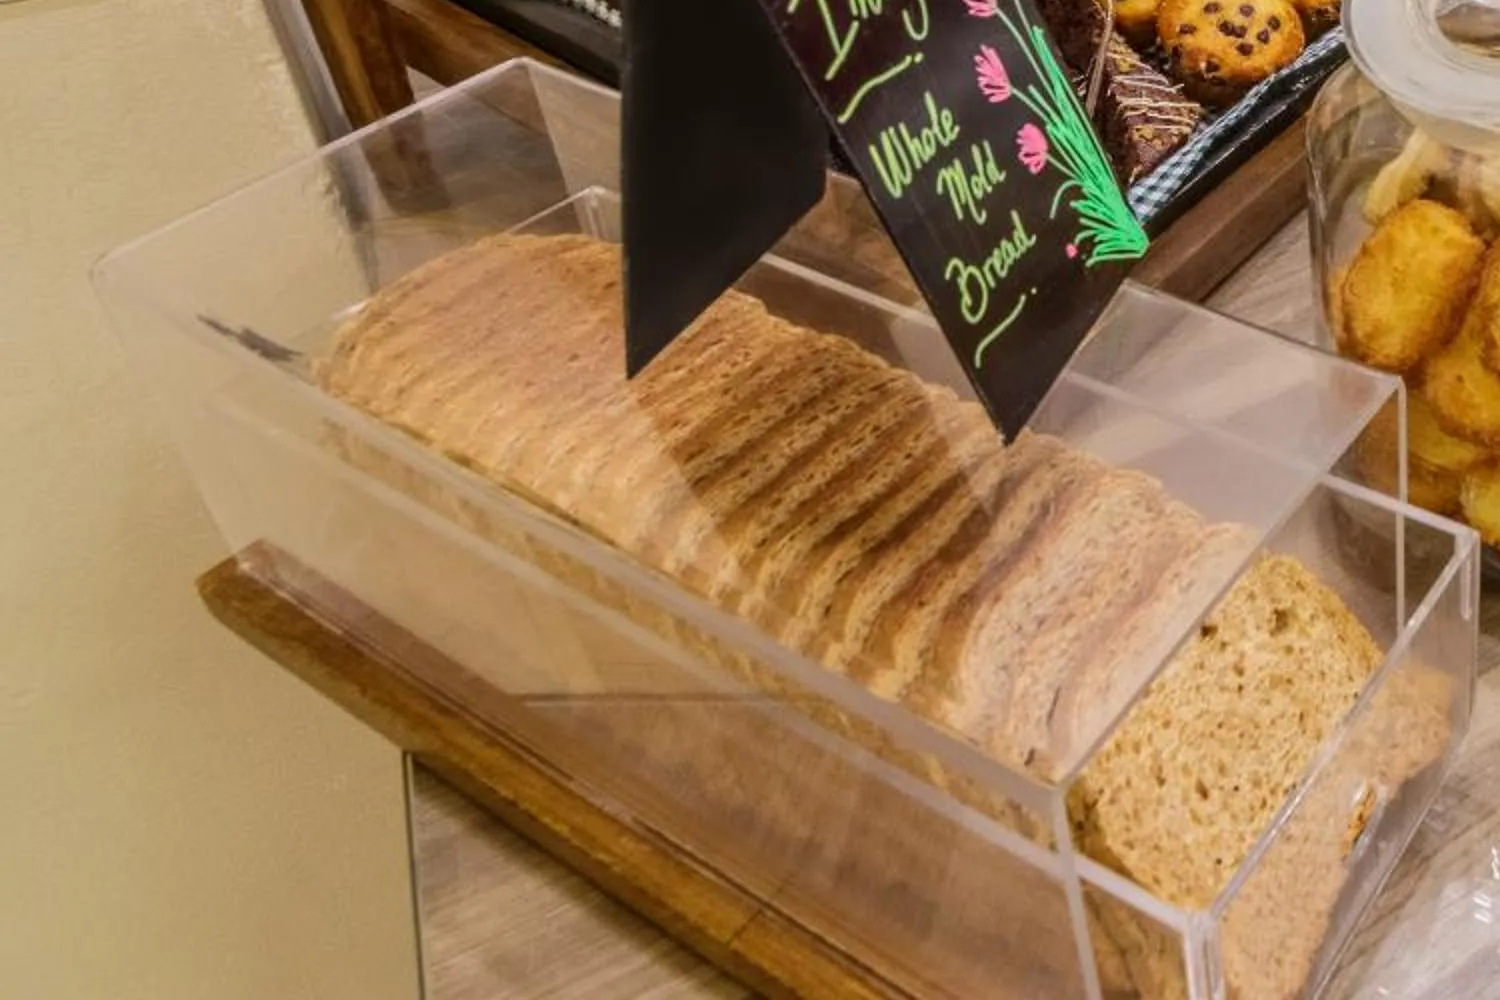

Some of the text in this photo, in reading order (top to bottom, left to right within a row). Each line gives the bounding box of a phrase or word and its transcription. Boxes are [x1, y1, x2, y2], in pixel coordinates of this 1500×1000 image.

[869, 91, 960, 198] Whole
[937, 140, 1005, 225] Mold
[945, 210, 1036, 324] Bread
